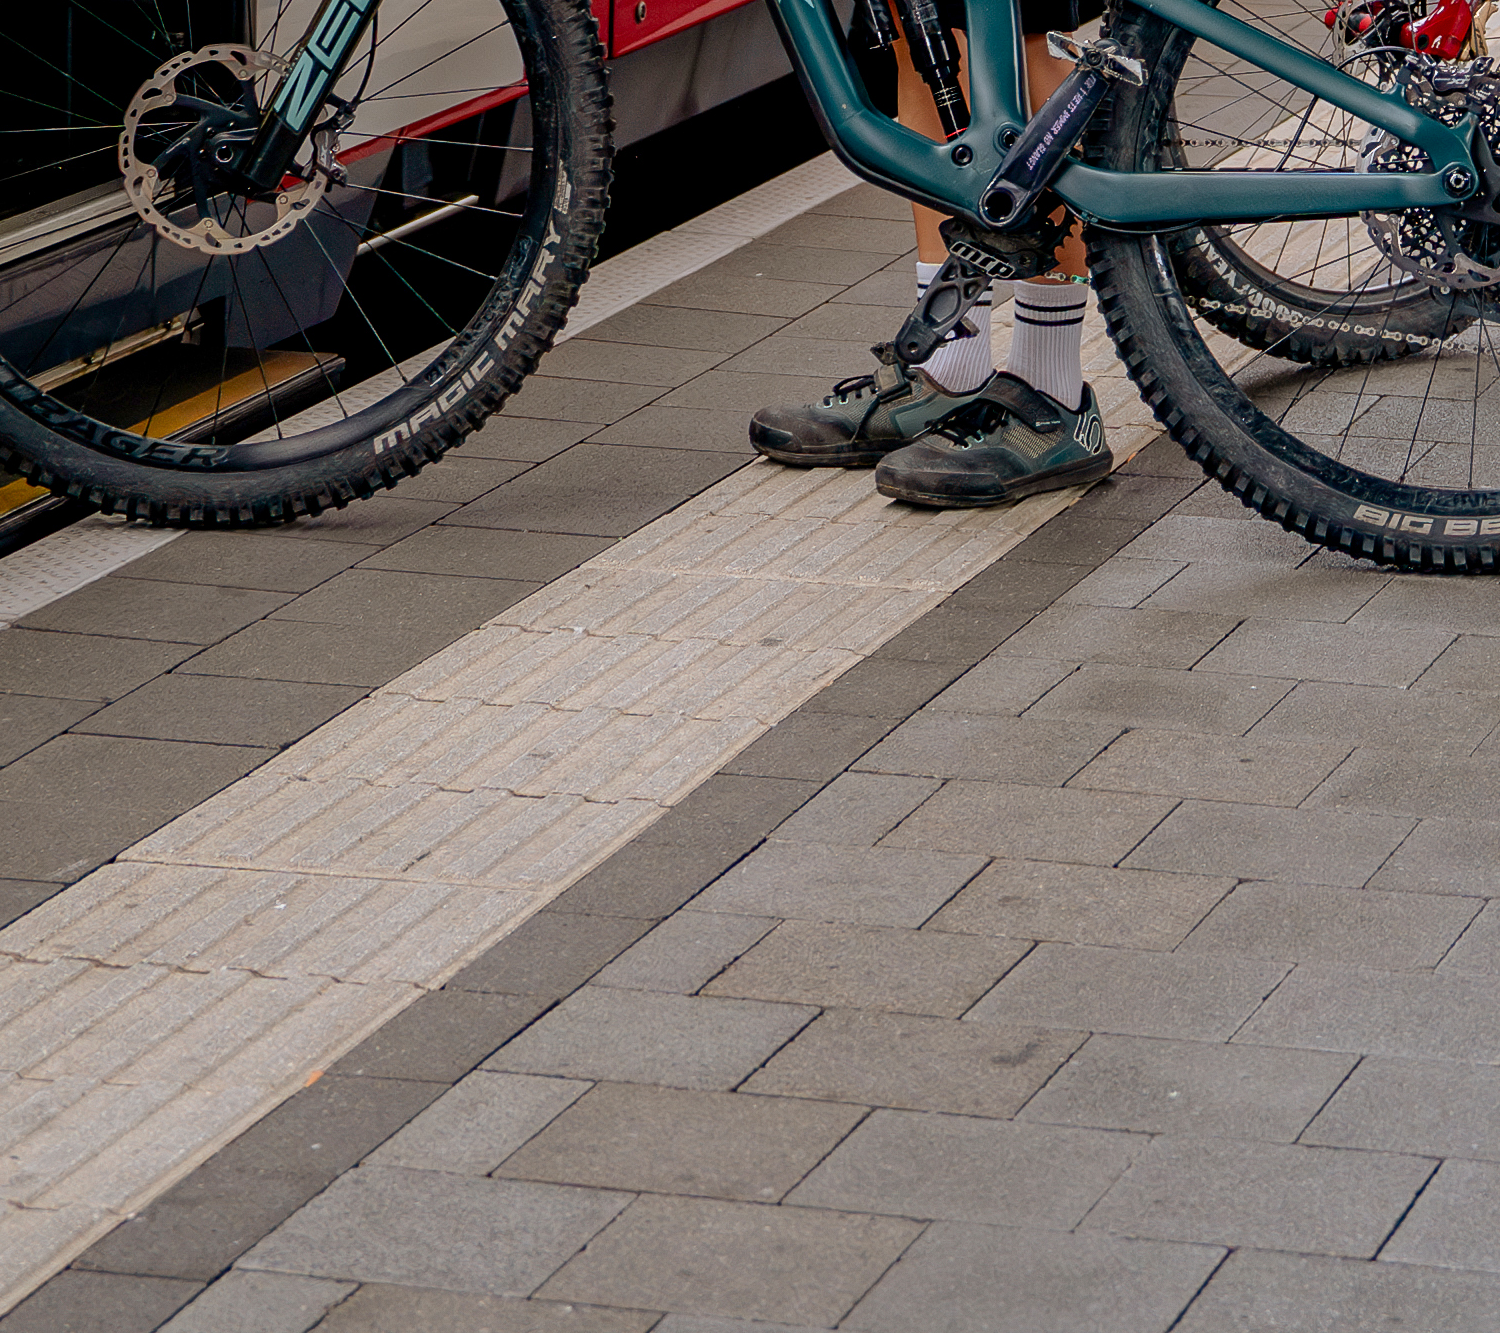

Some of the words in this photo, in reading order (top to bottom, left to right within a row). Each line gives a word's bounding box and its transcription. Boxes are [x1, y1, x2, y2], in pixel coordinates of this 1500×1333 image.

[952, 243, 1014, 277] mrp
[374, 351, 494, 454] MAGIC
[493, 219, 561, 351] MARY
[1353, 504, 1434, 536] BIG
